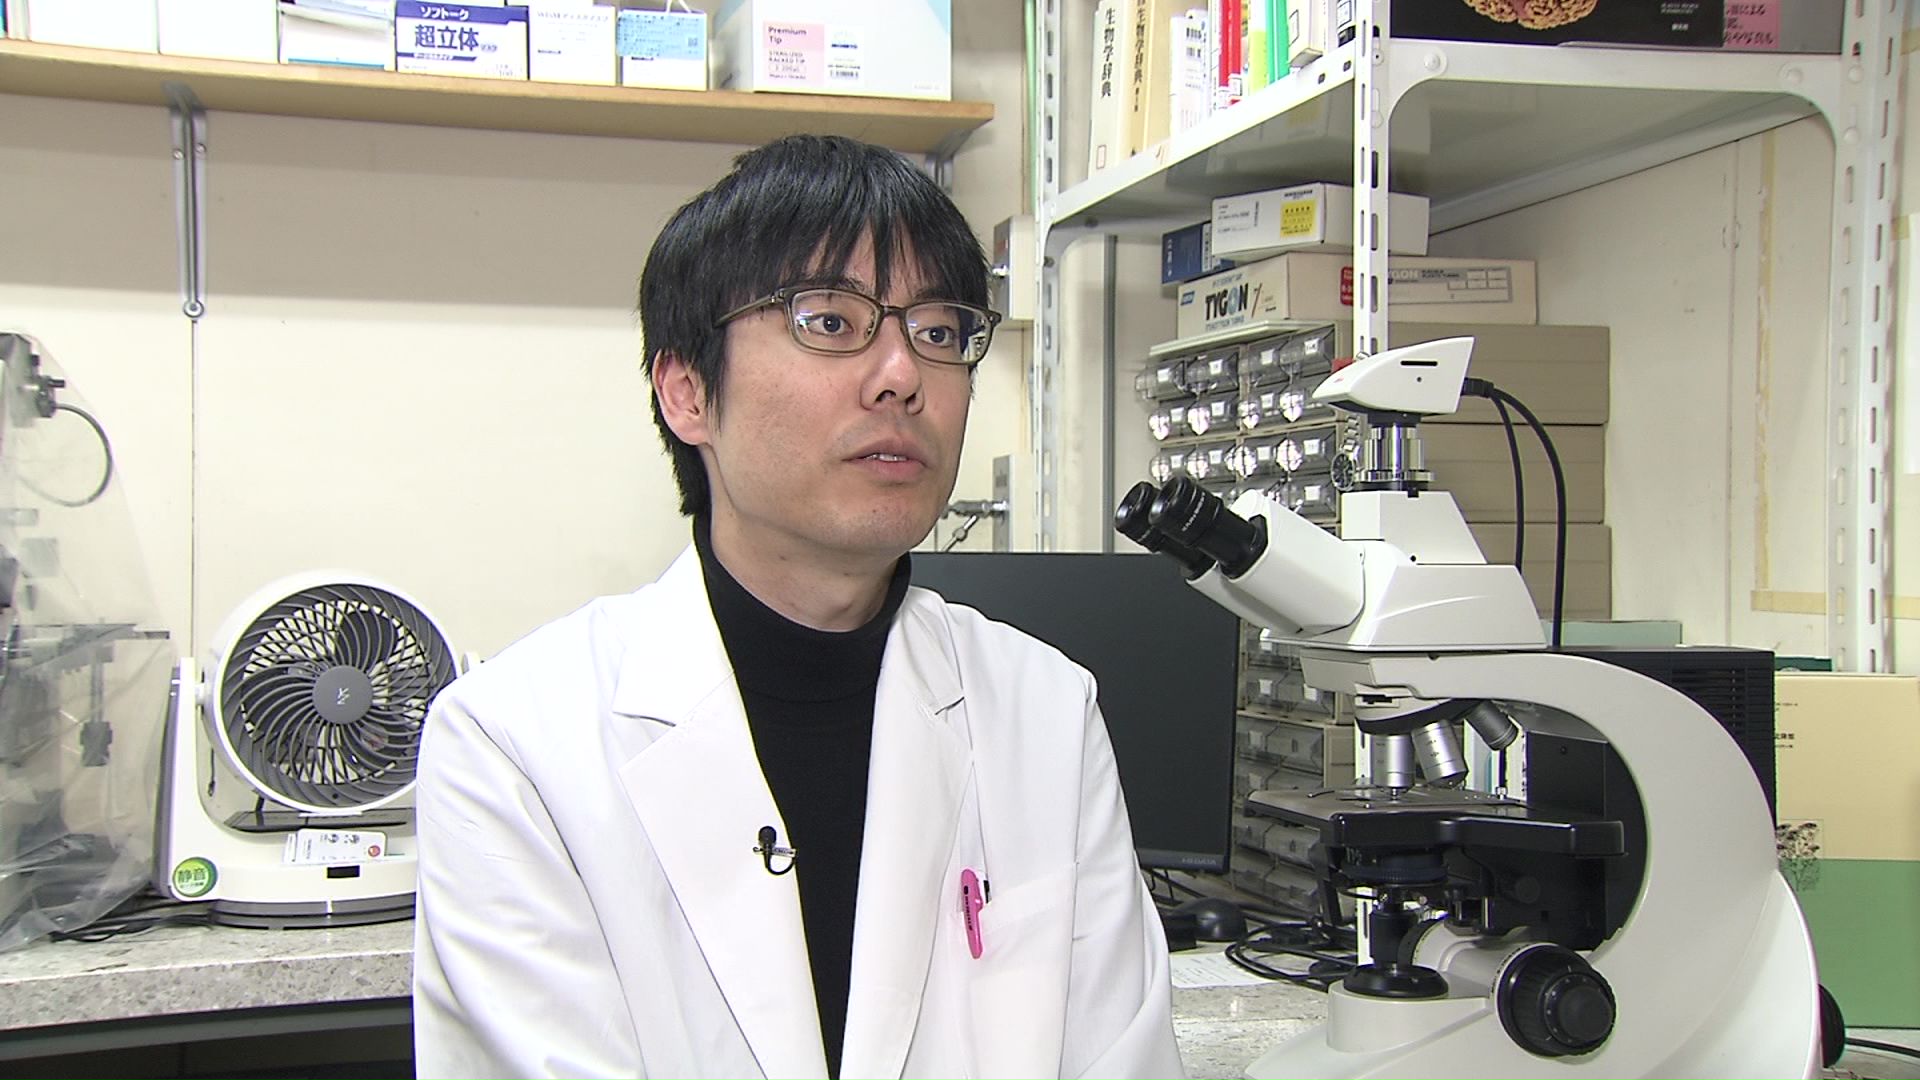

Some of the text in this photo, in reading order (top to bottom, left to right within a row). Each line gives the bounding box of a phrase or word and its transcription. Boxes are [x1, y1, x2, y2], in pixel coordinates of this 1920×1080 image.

[420, 6, 469, 21] ソフトーク
[415, 24, 479, 51] 超立体
[768, 26, 807, 36] Premium
[769, 36, 782, 44] Tip
[1101, 8, 1116, 98] 生物学辞典
[1205, 283, 1249, 321] TYGON
